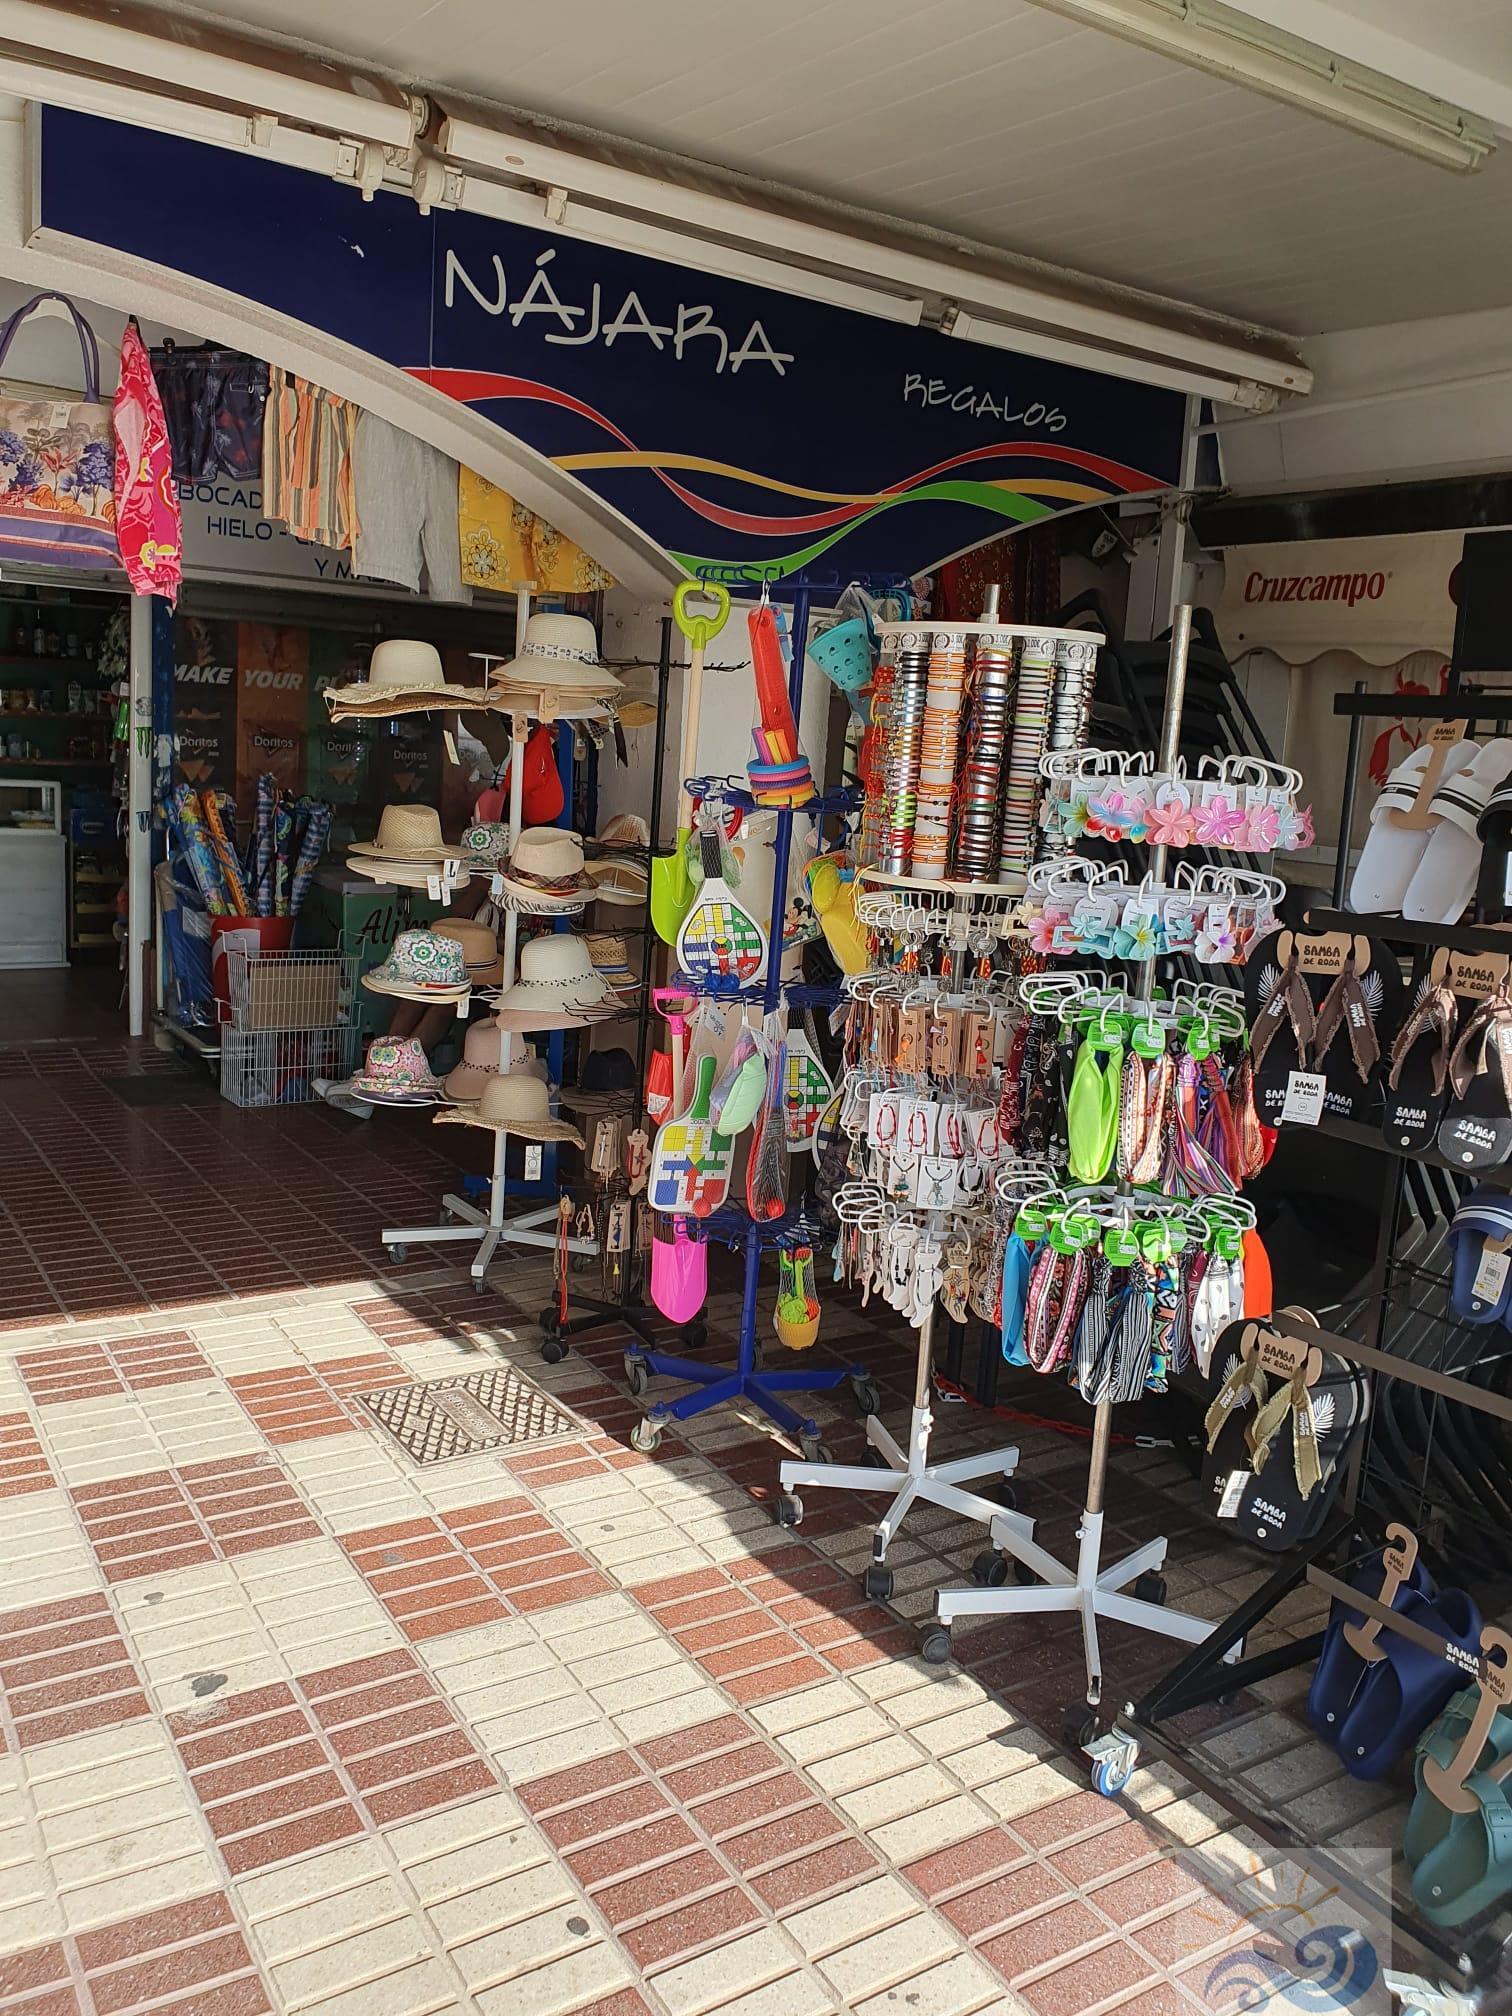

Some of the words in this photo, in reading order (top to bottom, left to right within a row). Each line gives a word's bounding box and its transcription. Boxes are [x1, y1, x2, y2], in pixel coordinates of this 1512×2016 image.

[445, 248, 795, 376] NÁJARA
[903, 373, 1067, 432] REGALOS
[207, 515, 273, 541] HIELO
[313, 557, 329, 577] Y
[1244, 571, 1386, 608] Cruzcampo
[173, 663, 234, 685] MAKE
[244, 669, 303, 691] YOUR
[179, 735, 219, 748] Doritos
[253, 735, 294, 749] Doritos
[393, 749, 429, 761] Doritos
[1303, 945, 1341, 958] SAMBA
[1303, 957, 1314, 965] DE
[1317, 958, 1340, 967] RODA
[1457, 966, 1495, 983] SAMBA
[1455, 980, 1466, 989] DE
[1469, 982, 1493, 993] RODA
[1265, 1089, 1286, 1099] SAM
[1294, 1080, 1319, 1092] SAMBA
[1325, 1092, 1352, 1107] AMBA
[1395, 1106, 1427, 1120] SAMBA
[1458, 1120, 1497, 1142] SAMBA
[1263, 1343, 1296, 1363] SAMBA
[1261, 1355, 1271, 1365] DE
[1273, 1360, 1294, 1373] RODA
[1251, 1507, 1262, 1517] DE
[1262, 1513, 1283, 1529] RODA
[1254, 1497, 1286, 1522] SAMBA
[1446, 1643, 1480, 1668] SAMBA
[1446, 1654, 1456, 1663] DE
[1458, 1660, 1479, 1676] RODA
[1487, 1671, 1506, 1692] AMBA
